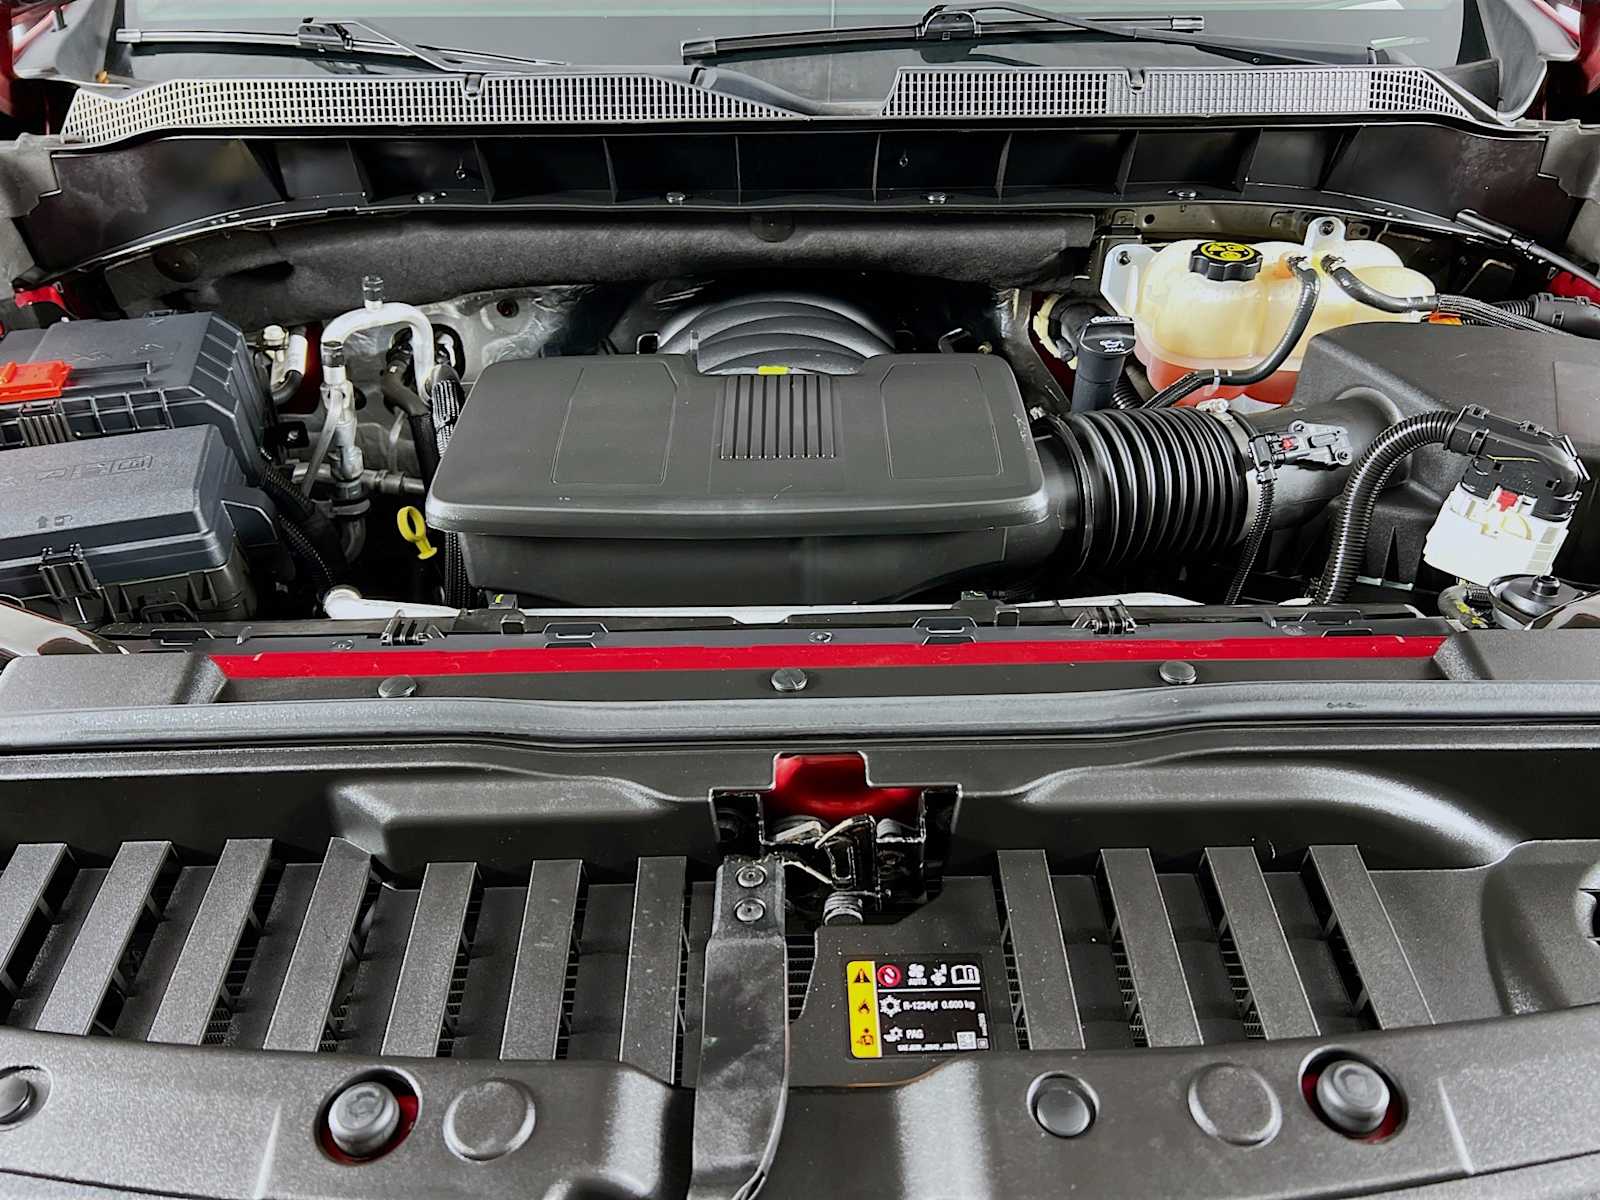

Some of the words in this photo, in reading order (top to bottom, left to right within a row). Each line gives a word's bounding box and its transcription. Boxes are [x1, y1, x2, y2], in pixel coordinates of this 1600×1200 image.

[902, 1000, 939, 1011] R-1234yf
[965, 1000, 976, 1011] kg
[905, 1029, 924, 1040] PAG
